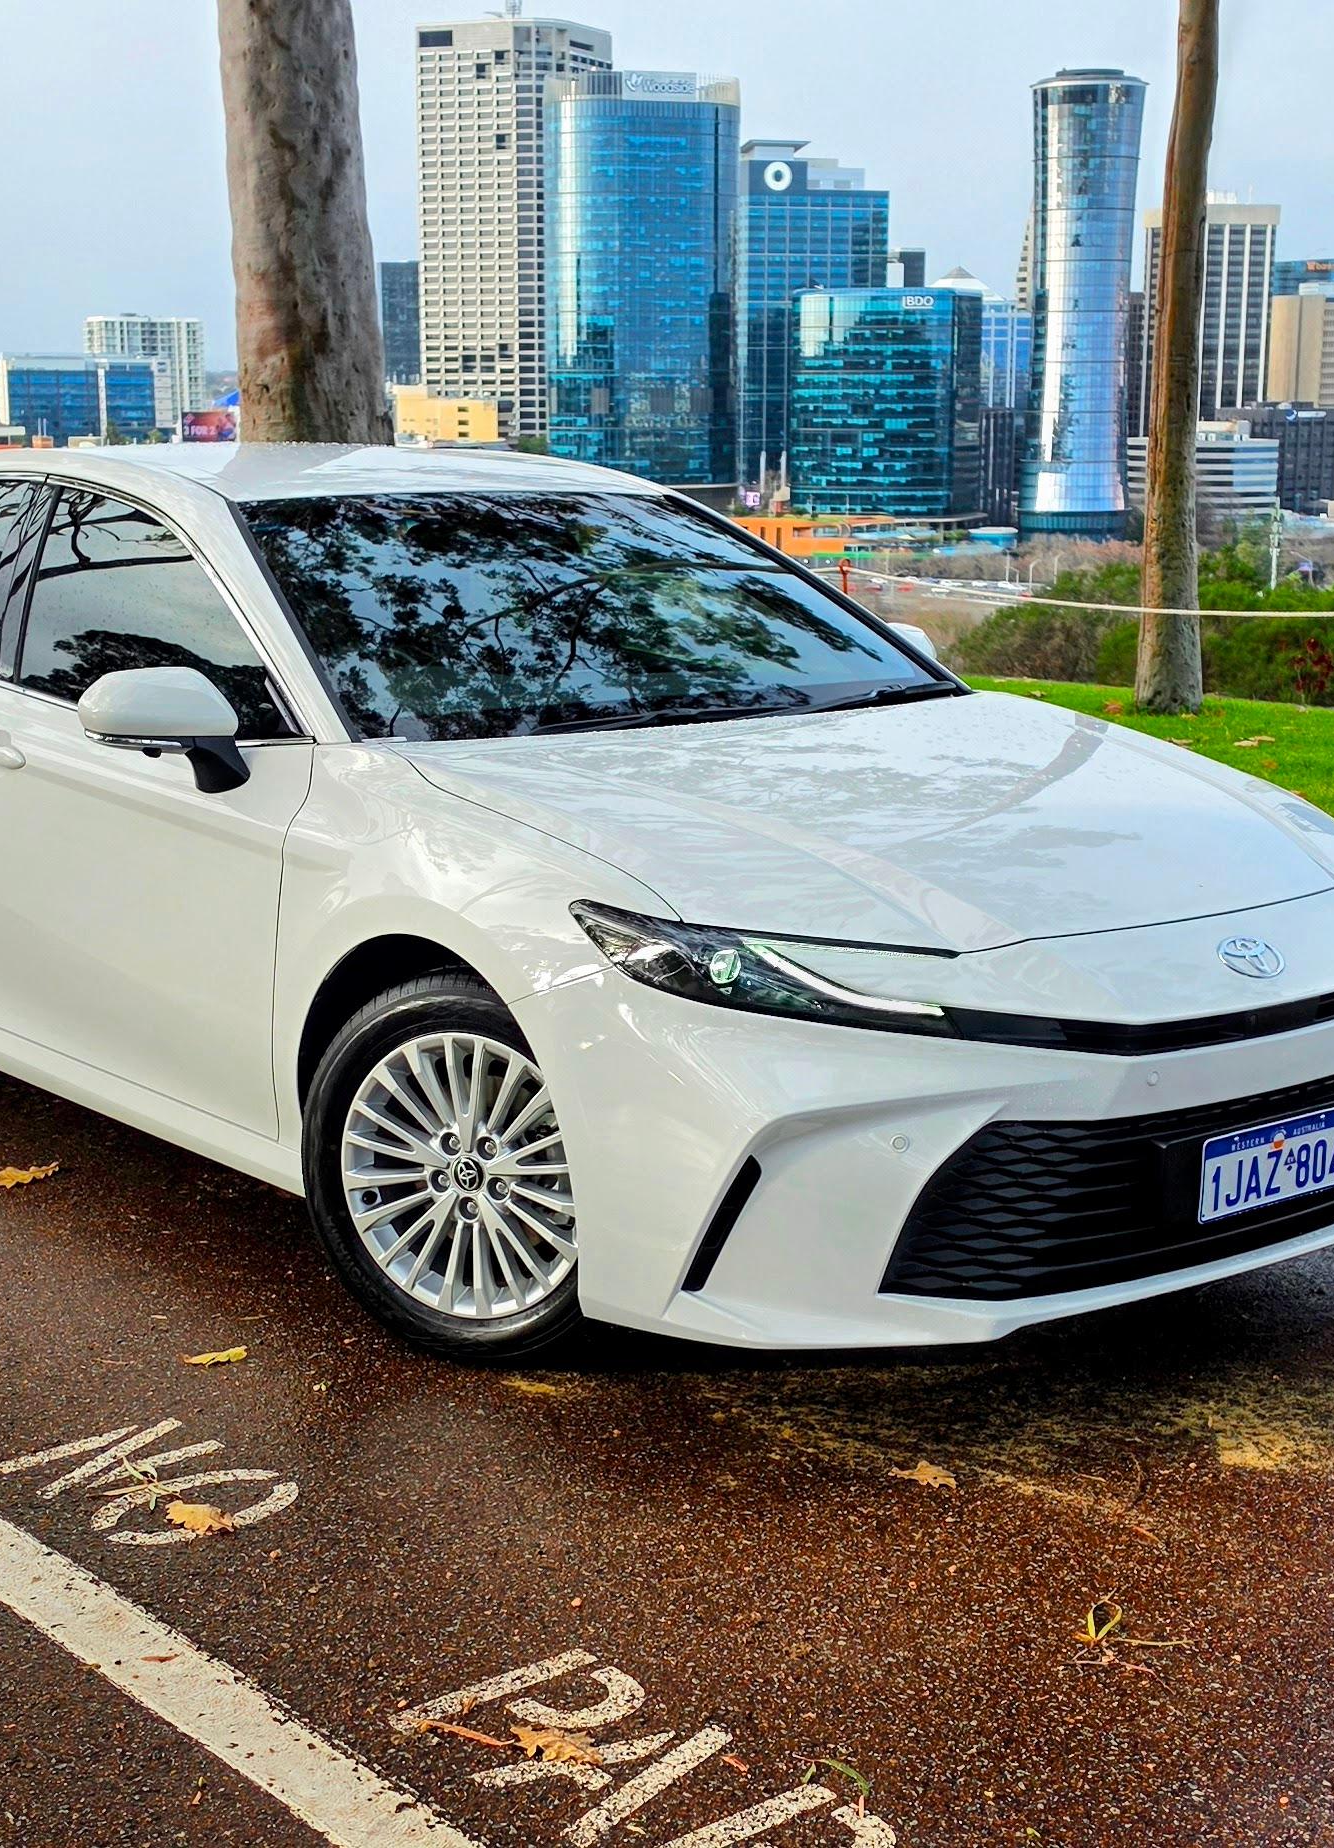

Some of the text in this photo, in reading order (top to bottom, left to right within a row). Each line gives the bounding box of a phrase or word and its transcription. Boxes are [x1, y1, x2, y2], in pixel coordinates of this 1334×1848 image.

[906, 296, 934, 306] BDO
[1231, 1121, 1326, 1152] WESTERN AUSTRALIA
